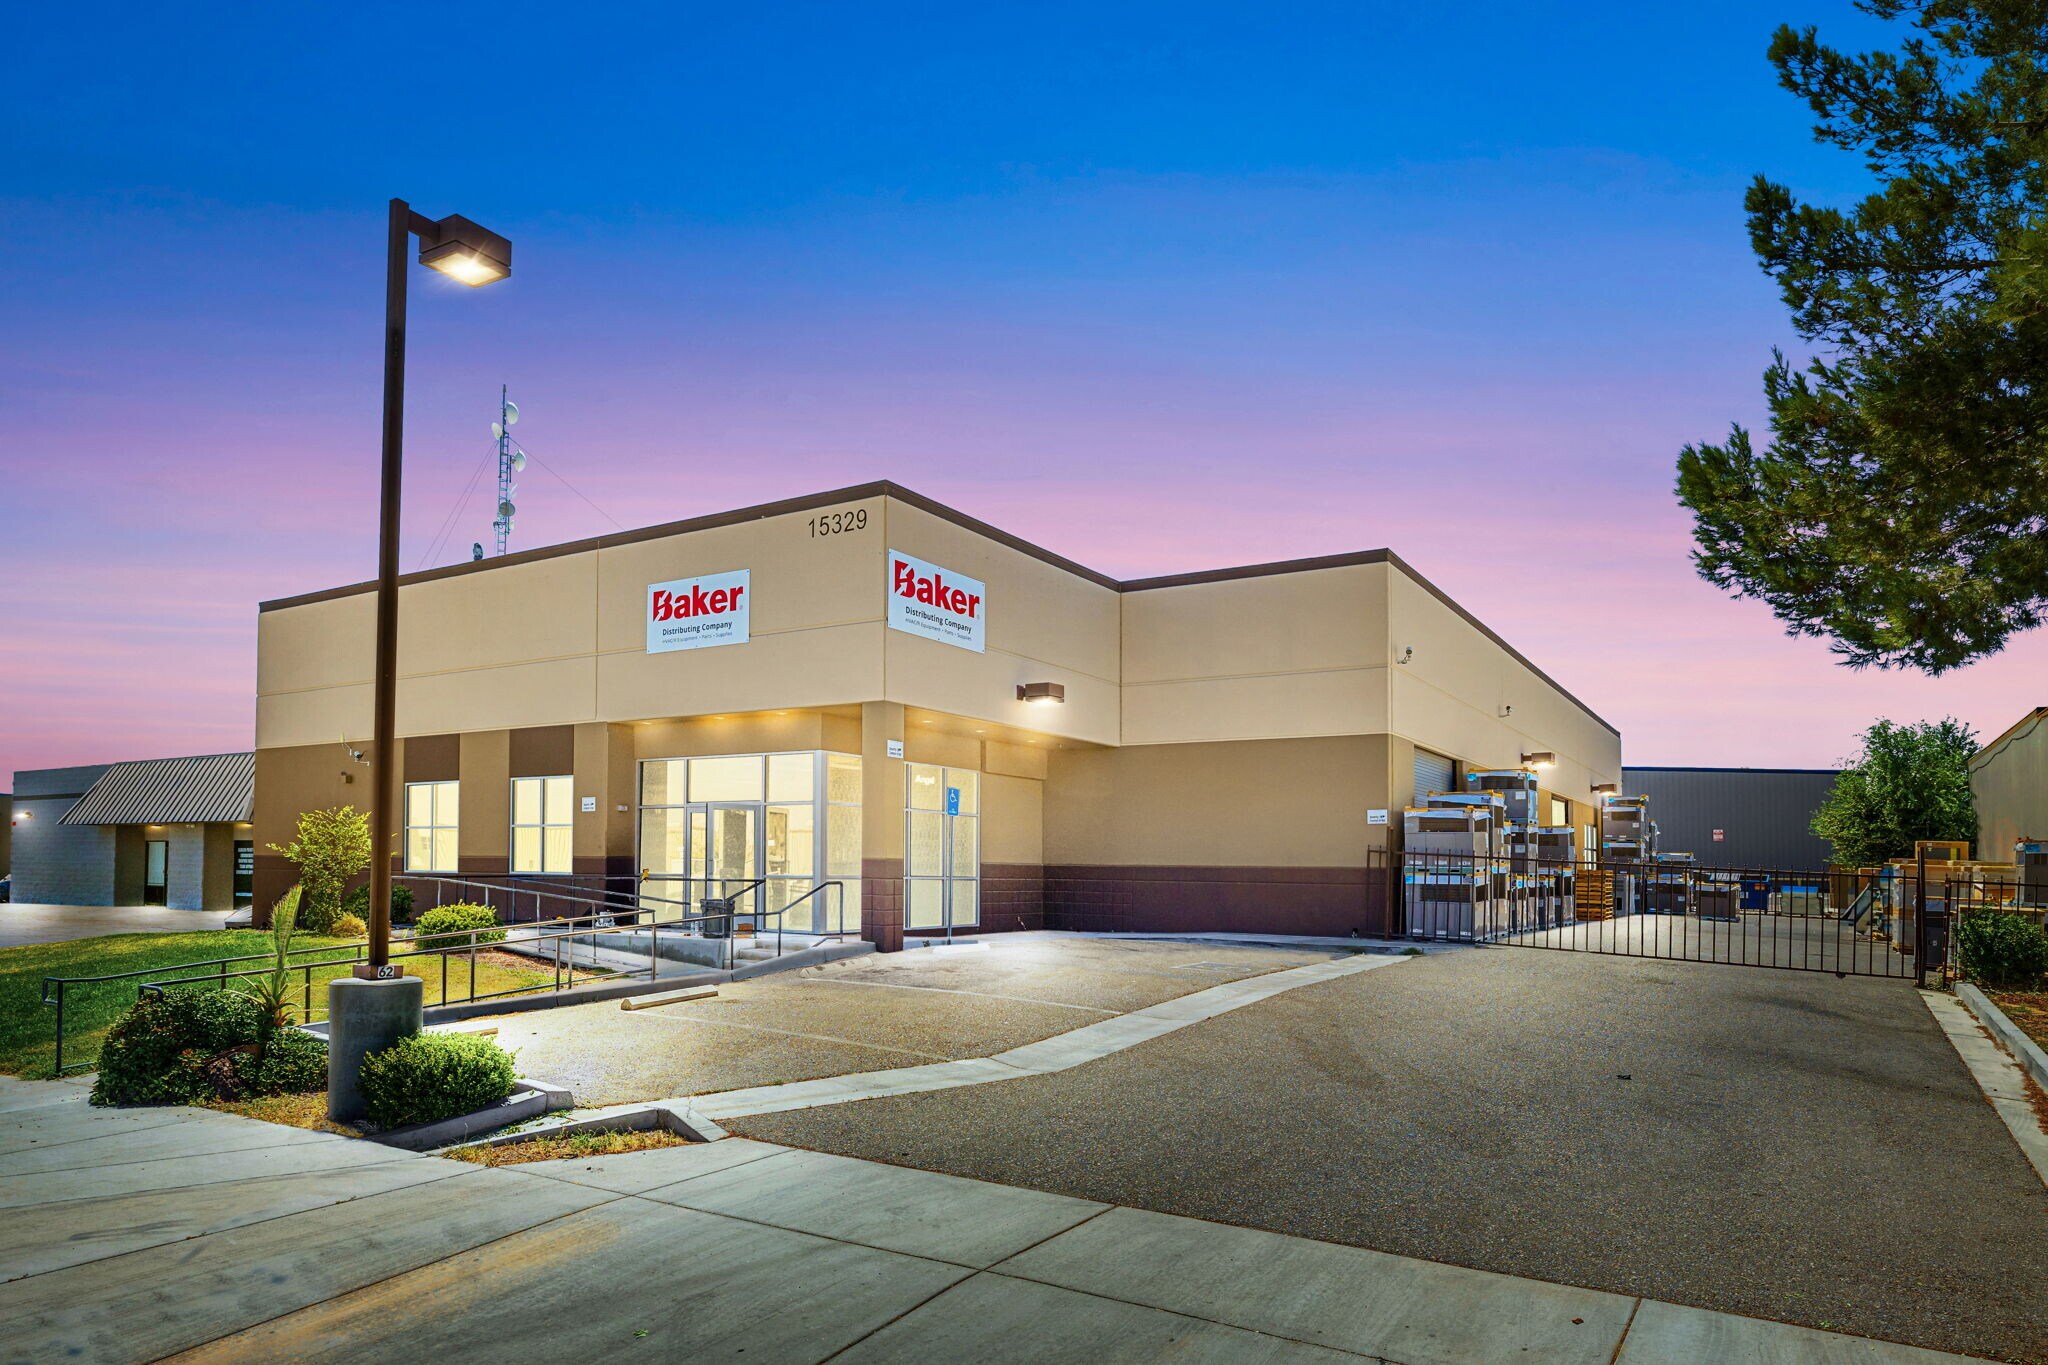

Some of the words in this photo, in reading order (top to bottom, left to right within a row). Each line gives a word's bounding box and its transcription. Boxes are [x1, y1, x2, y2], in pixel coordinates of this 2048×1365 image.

[808, 509, 867, 538] 15329
[894, 559, 980, 618] Baker
[653, 584, 744, 622] Baker
[662, 624, 700, 636] Distributing
[701, 621, 733, 632] Company
[905, 606, 943, 626] Distributing
[944, 618, 972, 634] Company
[379, 966, 393, 977] 62
